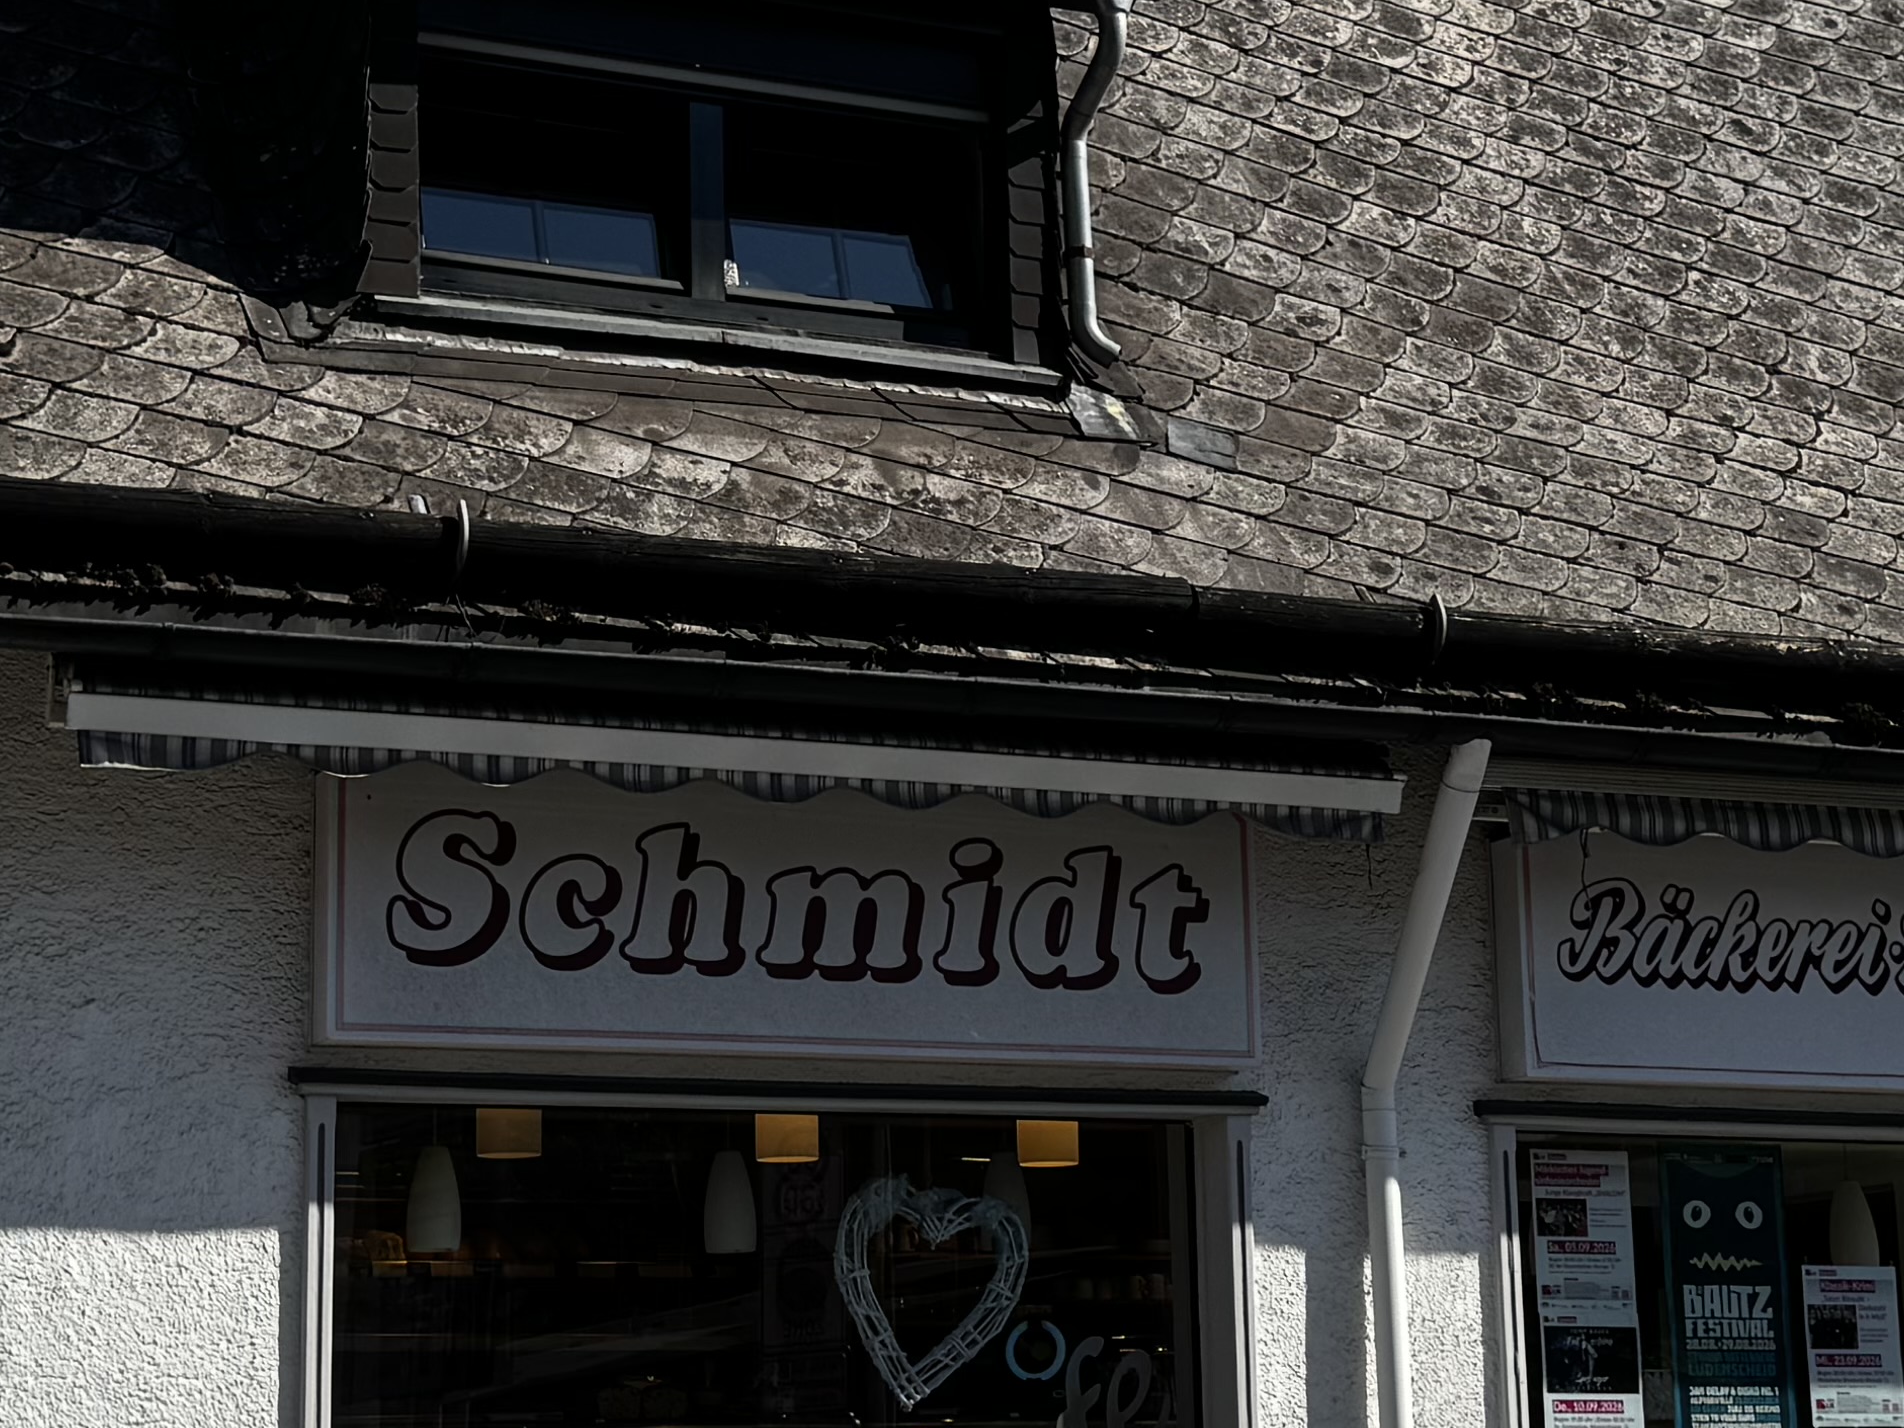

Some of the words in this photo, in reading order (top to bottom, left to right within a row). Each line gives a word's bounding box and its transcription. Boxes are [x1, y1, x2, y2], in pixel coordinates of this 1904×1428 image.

[385, 807, 1210, 996] Schmidt
[1683, 1284, 1773, 1319] BAUTZ
[1685, 1319, 1775, 1338] FESTIVAL
